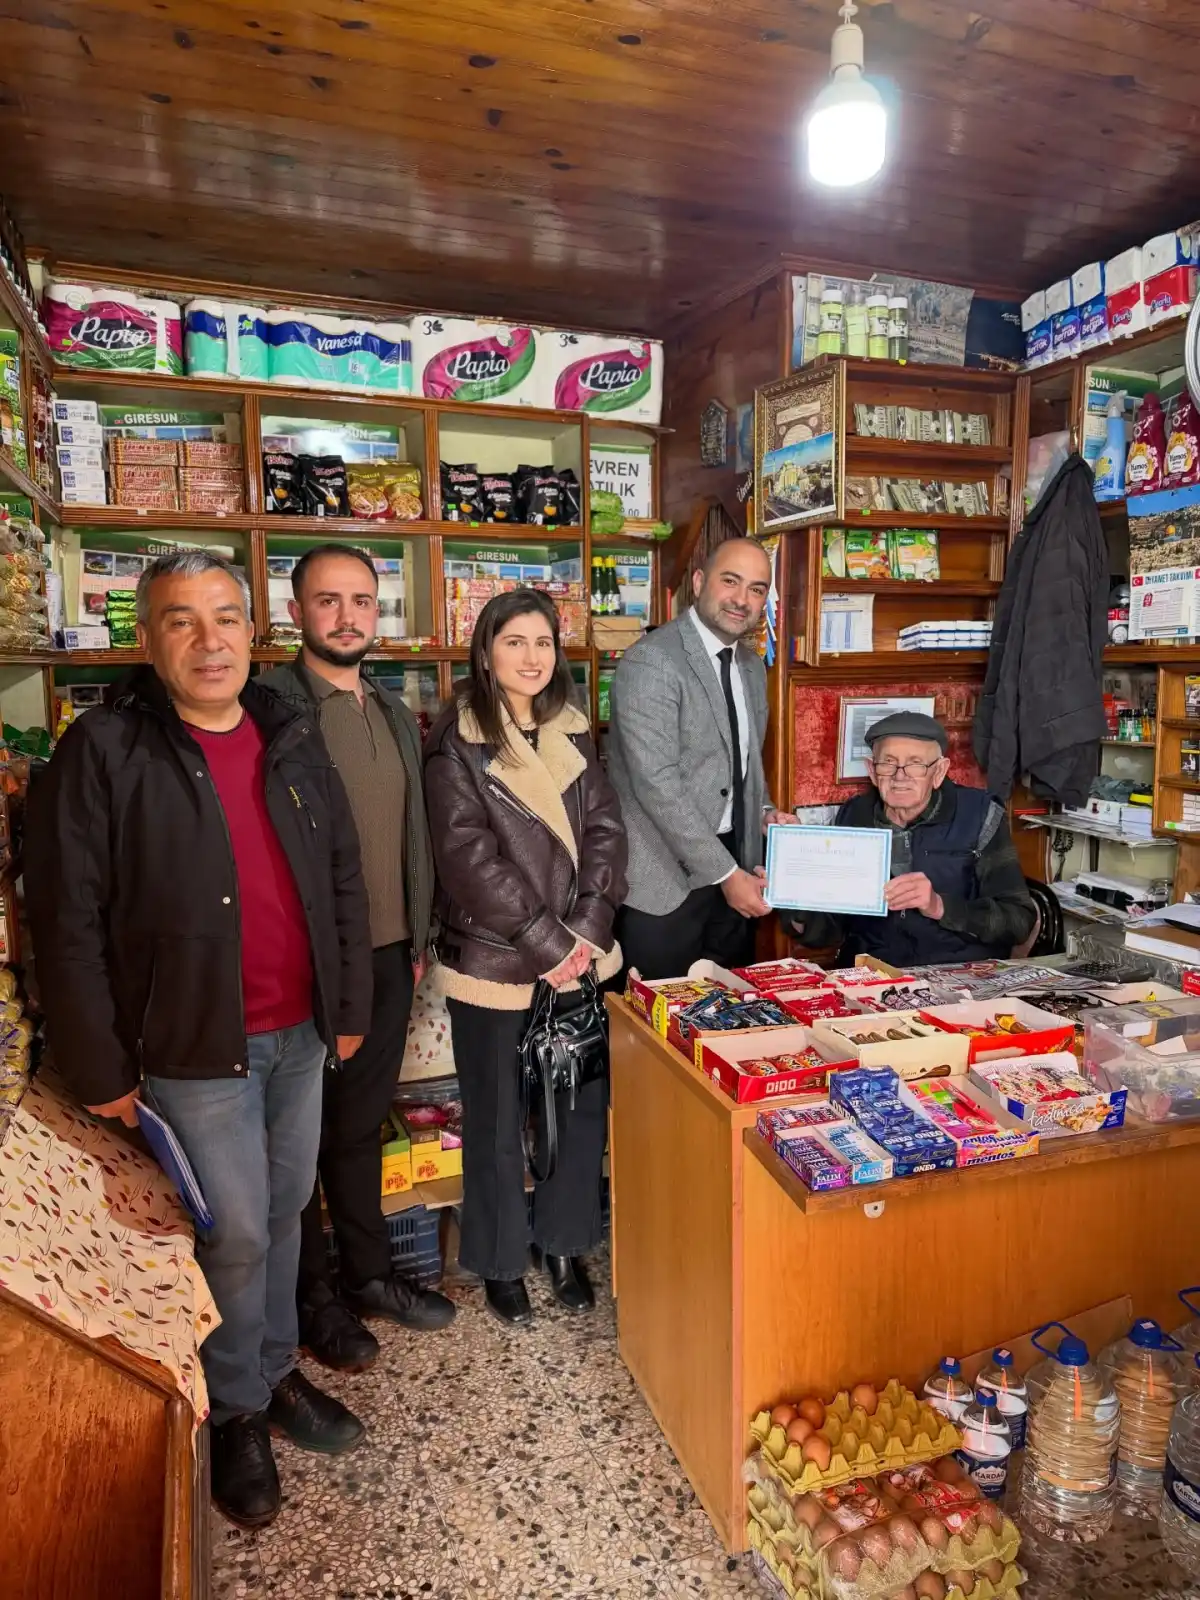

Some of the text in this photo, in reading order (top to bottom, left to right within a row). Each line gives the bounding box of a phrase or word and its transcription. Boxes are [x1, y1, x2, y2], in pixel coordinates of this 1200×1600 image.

[78, 316, 147, 350] Papia
[423, 320, 432, 336] 3
[317, 333, 363, 351] Vanesa
[560, 334, 568, 348] 3
[453, 350, 507, 380] Papia
[584, 360, 638, 392] Papia
[883, 1135, 913, 1145] ONEO
[914, 1130, 944, 1139] ONEO
[966, 1151, 1016, 1165] mentos
[913, 1163, 937, 1173] ONEO
[816, 1173, 842, 1183] FALIM
